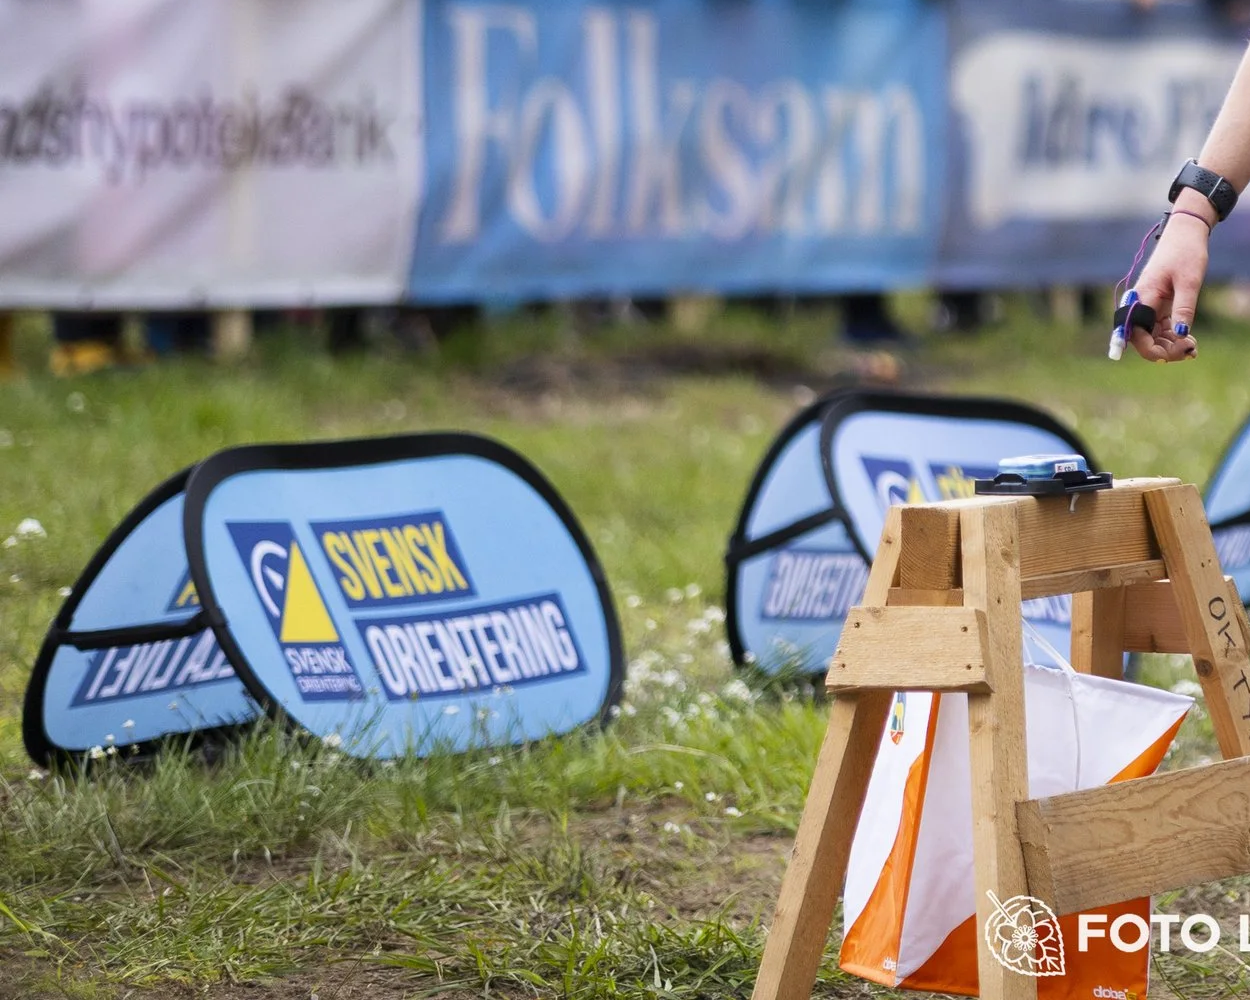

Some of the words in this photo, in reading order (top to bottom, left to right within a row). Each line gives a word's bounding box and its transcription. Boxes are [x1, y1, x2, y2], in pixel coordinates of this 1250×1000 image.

[438, 3, 926, 244] Folksam
[322, 521, 469, 602] SVENSK
[285, 646, 352, 675] SVENSK
[365, 600, 579, 697] ORIENTERING
[1208, 596, 1237, 658] OK
